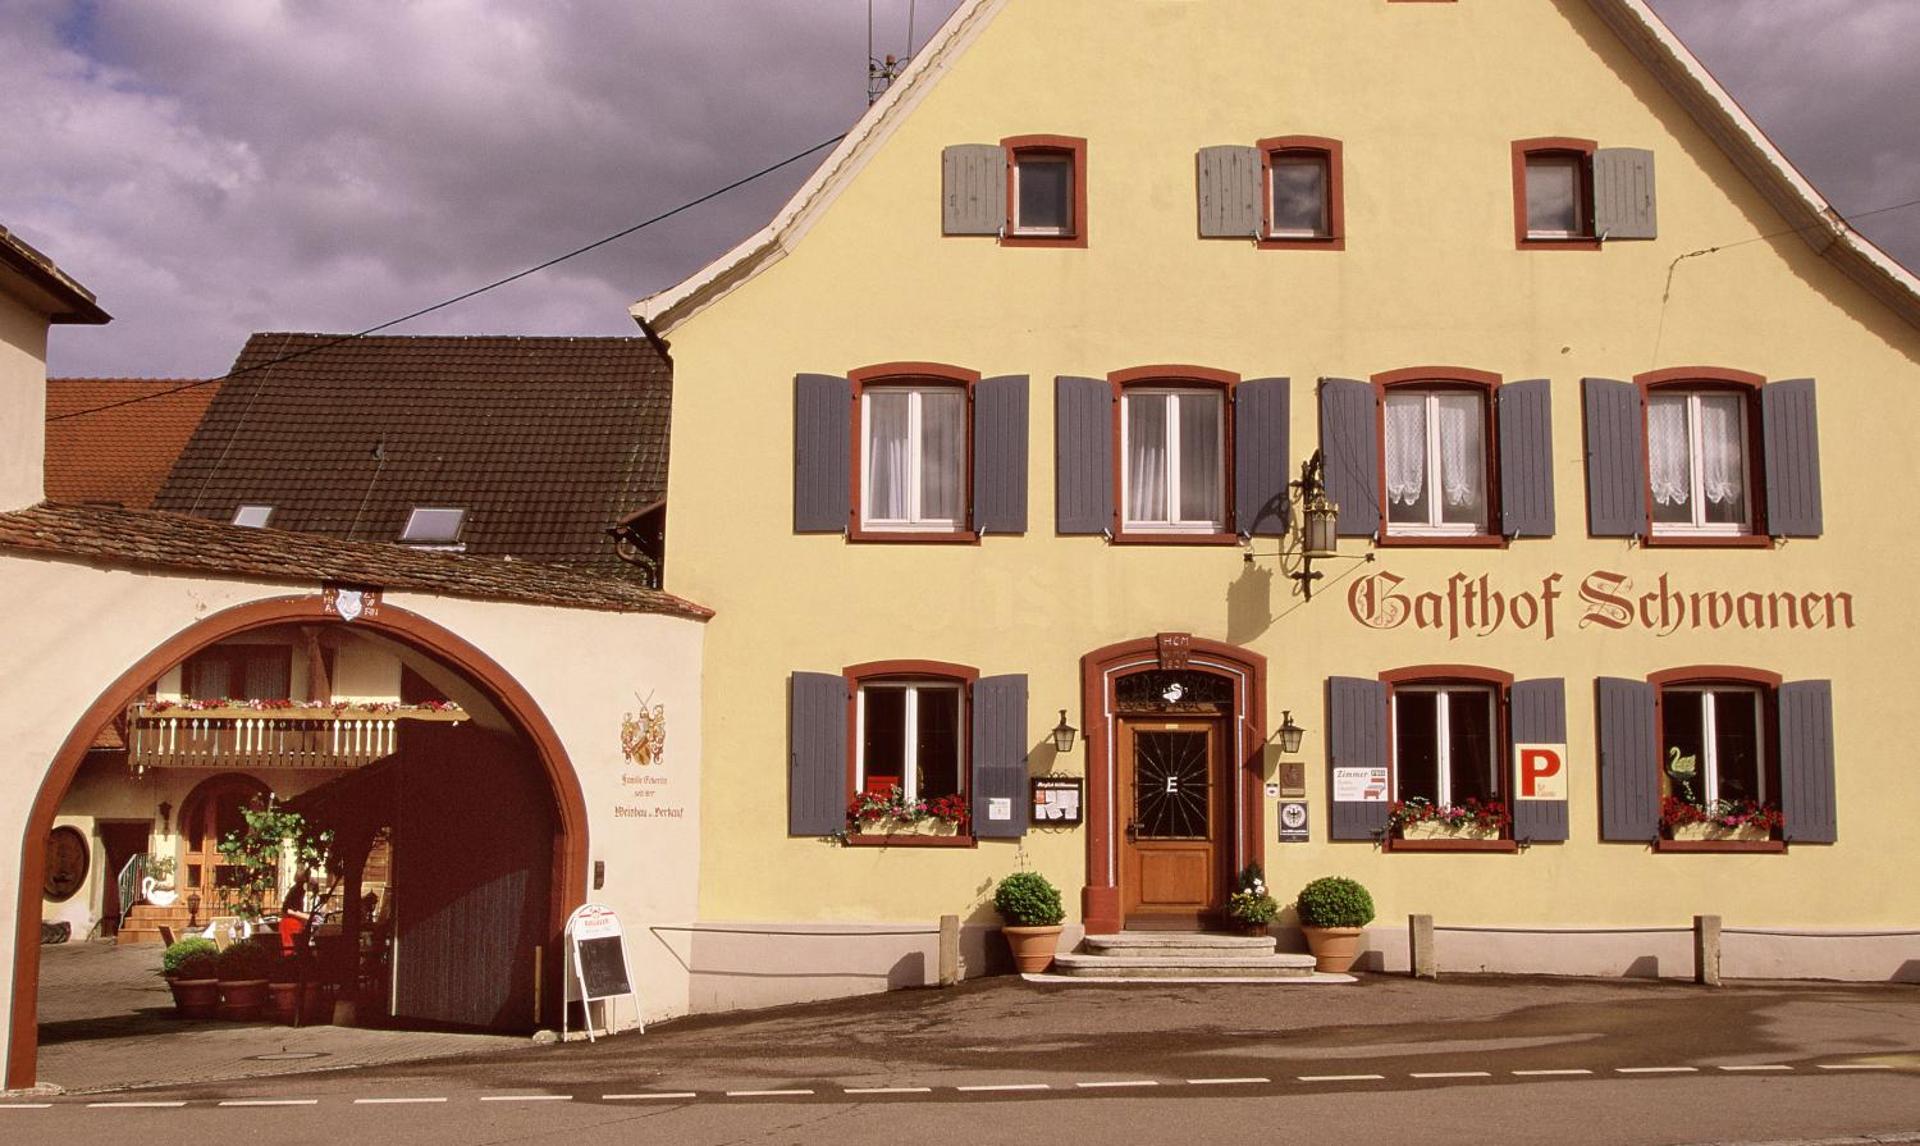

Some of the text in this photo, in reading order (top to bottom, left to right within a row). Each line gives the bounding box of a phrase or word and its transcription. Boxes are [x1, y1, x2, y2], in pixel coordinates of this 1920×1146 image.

[1578, 570, 1857, 637] Schwanen
[1166, 776, 1178, 792] E
[1336, 769, 1369, 778] Zimmer
[1521, 749, 1561, 797] P
